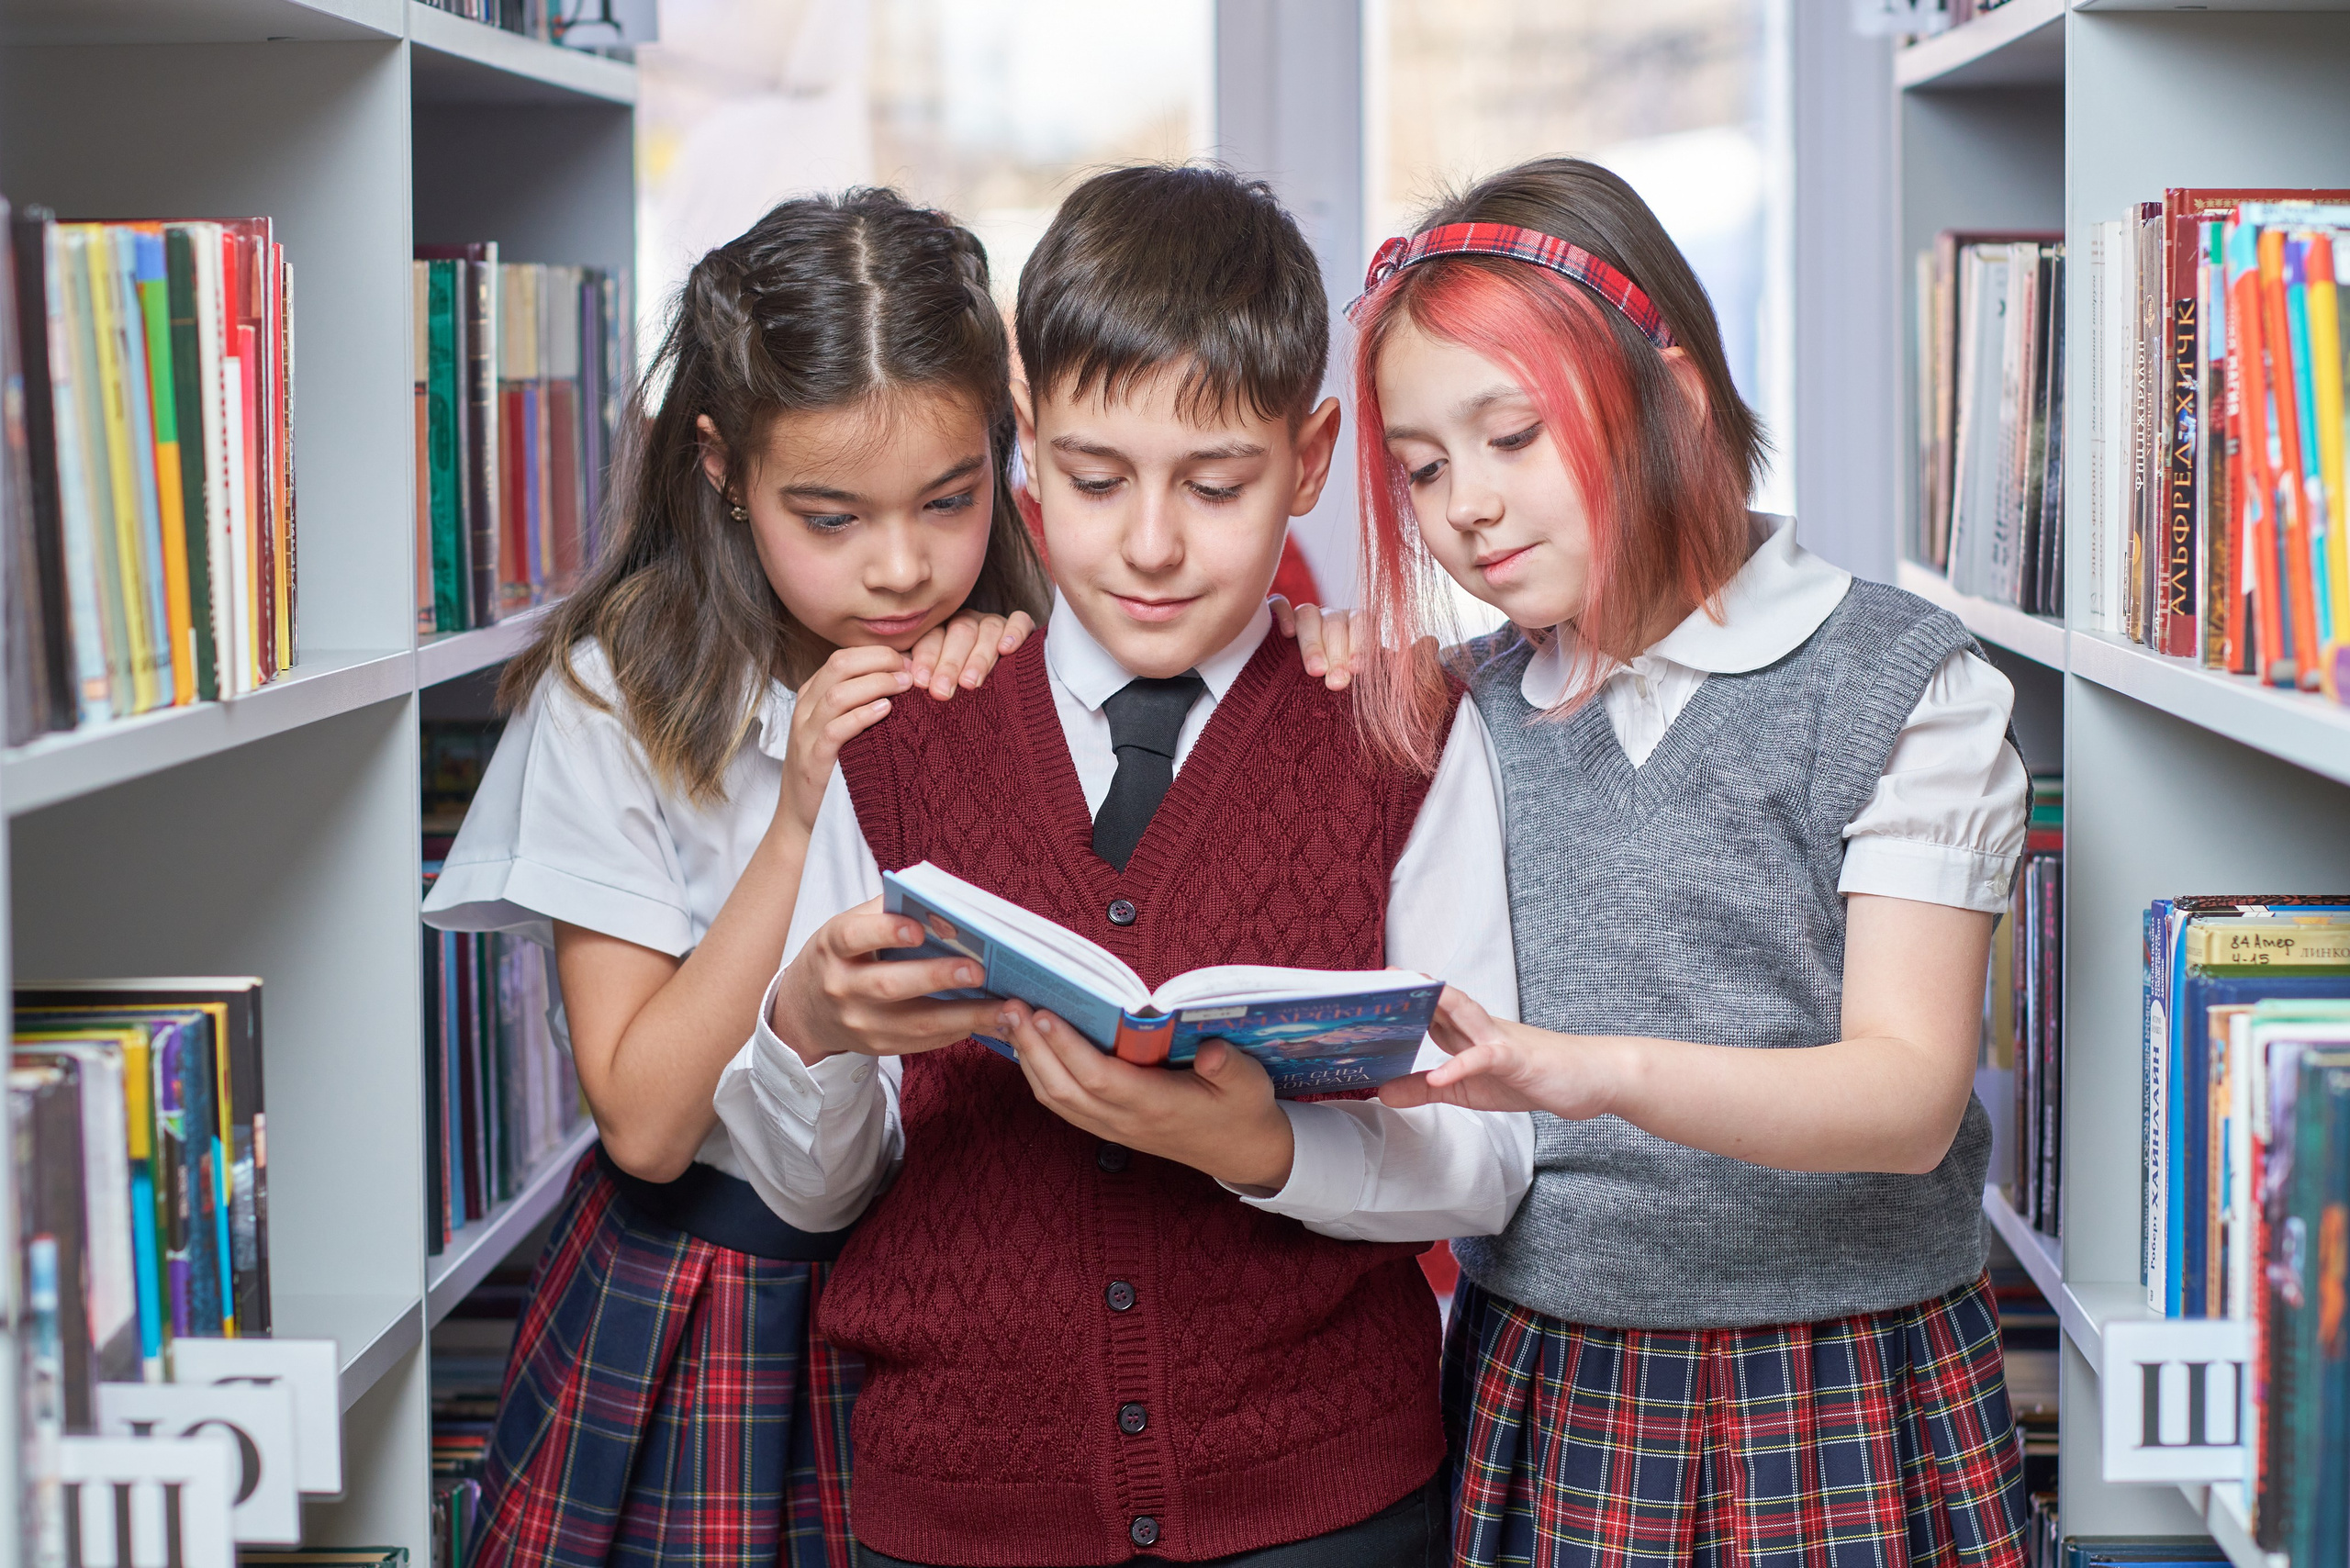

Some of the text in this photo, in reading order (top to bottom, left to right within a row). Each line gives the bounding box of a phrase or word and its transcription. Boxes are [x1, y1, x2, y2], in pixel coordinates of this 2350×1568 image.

[2170, 442, 2194, 617] АЛЬФРЕД
[1310, 1066, 1364, 1080] СНЫ
[2151, 1046, 2160, 1210] ХАЙНЛАЙН
[2150, 1214, 2158, 1270] Роберт
